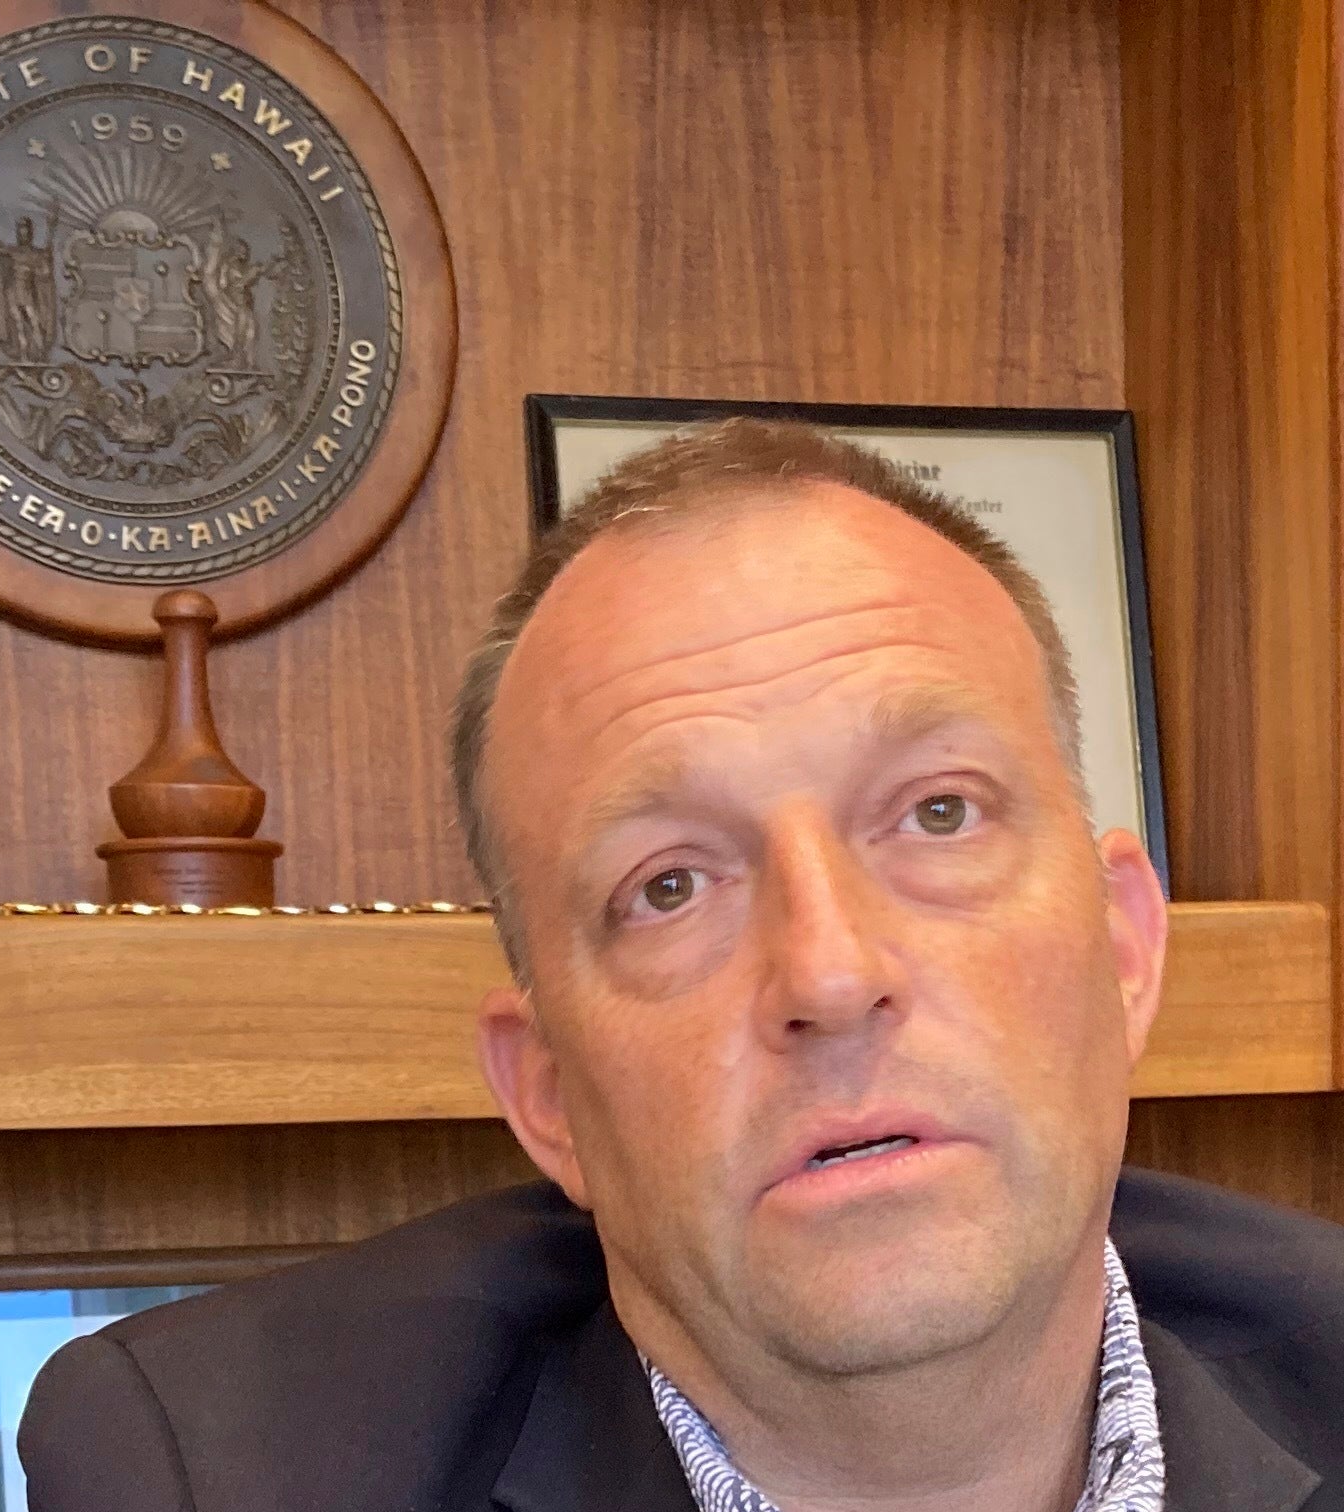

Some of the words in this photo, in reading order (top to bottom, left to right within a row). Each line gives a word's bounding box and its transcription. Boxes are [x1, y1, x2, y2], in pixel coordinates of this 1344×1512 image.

[70, 112, 188, 151] 1959
[84, 44, 153, 73] OF
[182, 59, 346, 201] HAWAII
[19, 494, 67, 534] EA
[80, 520, 103, 546] O
[121, 524, 172, 552] KA
[187, 496, 280, 549] AINA
[295, 434, 341, 484] KA
[331, 339, 377, 428] PONO
